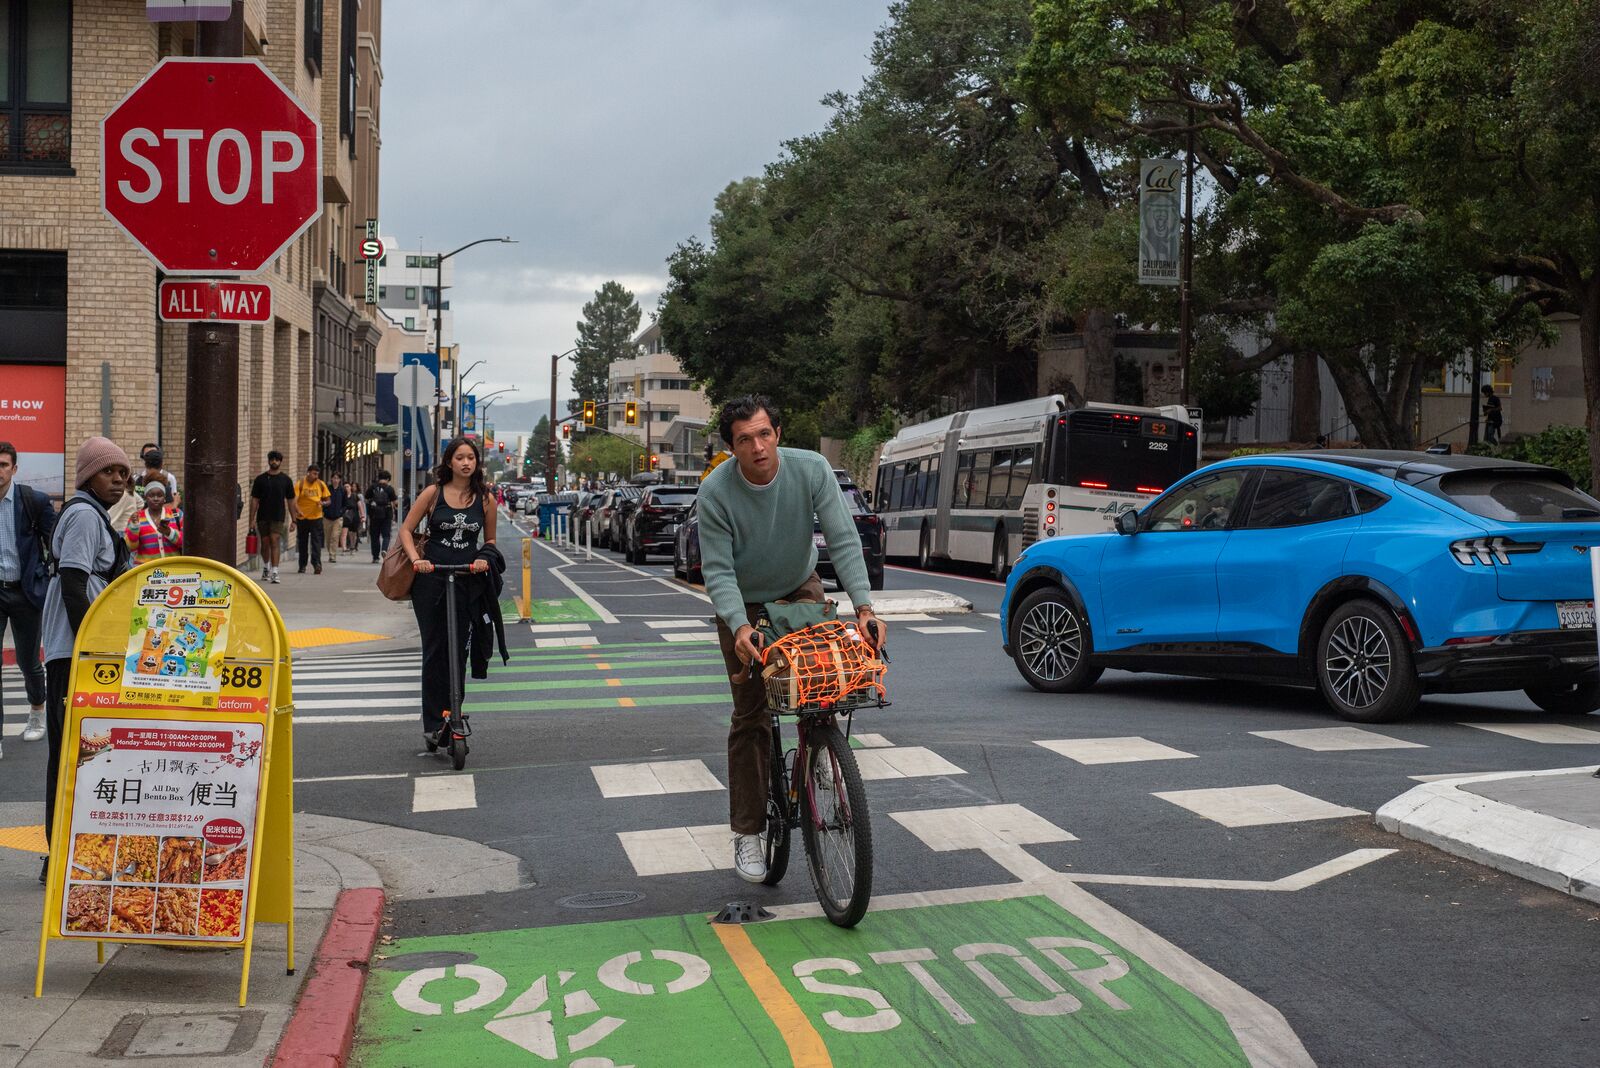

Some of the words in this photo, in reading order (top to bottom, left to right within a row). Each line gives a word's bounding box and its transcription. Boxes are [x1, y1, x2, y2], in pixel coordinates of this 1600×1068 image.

[117, 127, 305, 206] STOP
[1145, 165, 1179, 192] Cal
[1142, 260, 1177, 269] CALIFORNIA
[363, 241, 380, 303] STANDARD
[168, 283, 204, 313] ALL
[220, 283, 263, 314] WAY
[12, 400, 44, 410] NOW
[1152, 423, 1167, 435] 52
[1148, 441, 1169, 451] 2252
[440, 537, 451, 547] Las
[453, 541, 469, 549] Vegas
[220, 666, 262, 688] $88
[95, 696, 116, 705] No.1
[127, 731, 159, 739] 周一至周日
[159, 733, 217, 741] 11:00AM~20:00PM
[143, 740, 168, 748] Sunday
[168, 741, 226, 749] 11:00AM~20:00PM
[92, 777, 142, 805] 每日
[187, 780, 238, 809] 便当
[165, 785, 181, 793] Day
[144, 793, 168, 801] Bento
[169, 793, 184, 801] Box
[89, 810, 147, 821] 任意2菜$11.79
[148, 812, 204, 823] 任意3菜$12.69
[792, 936, 1133, 1034] STOP
